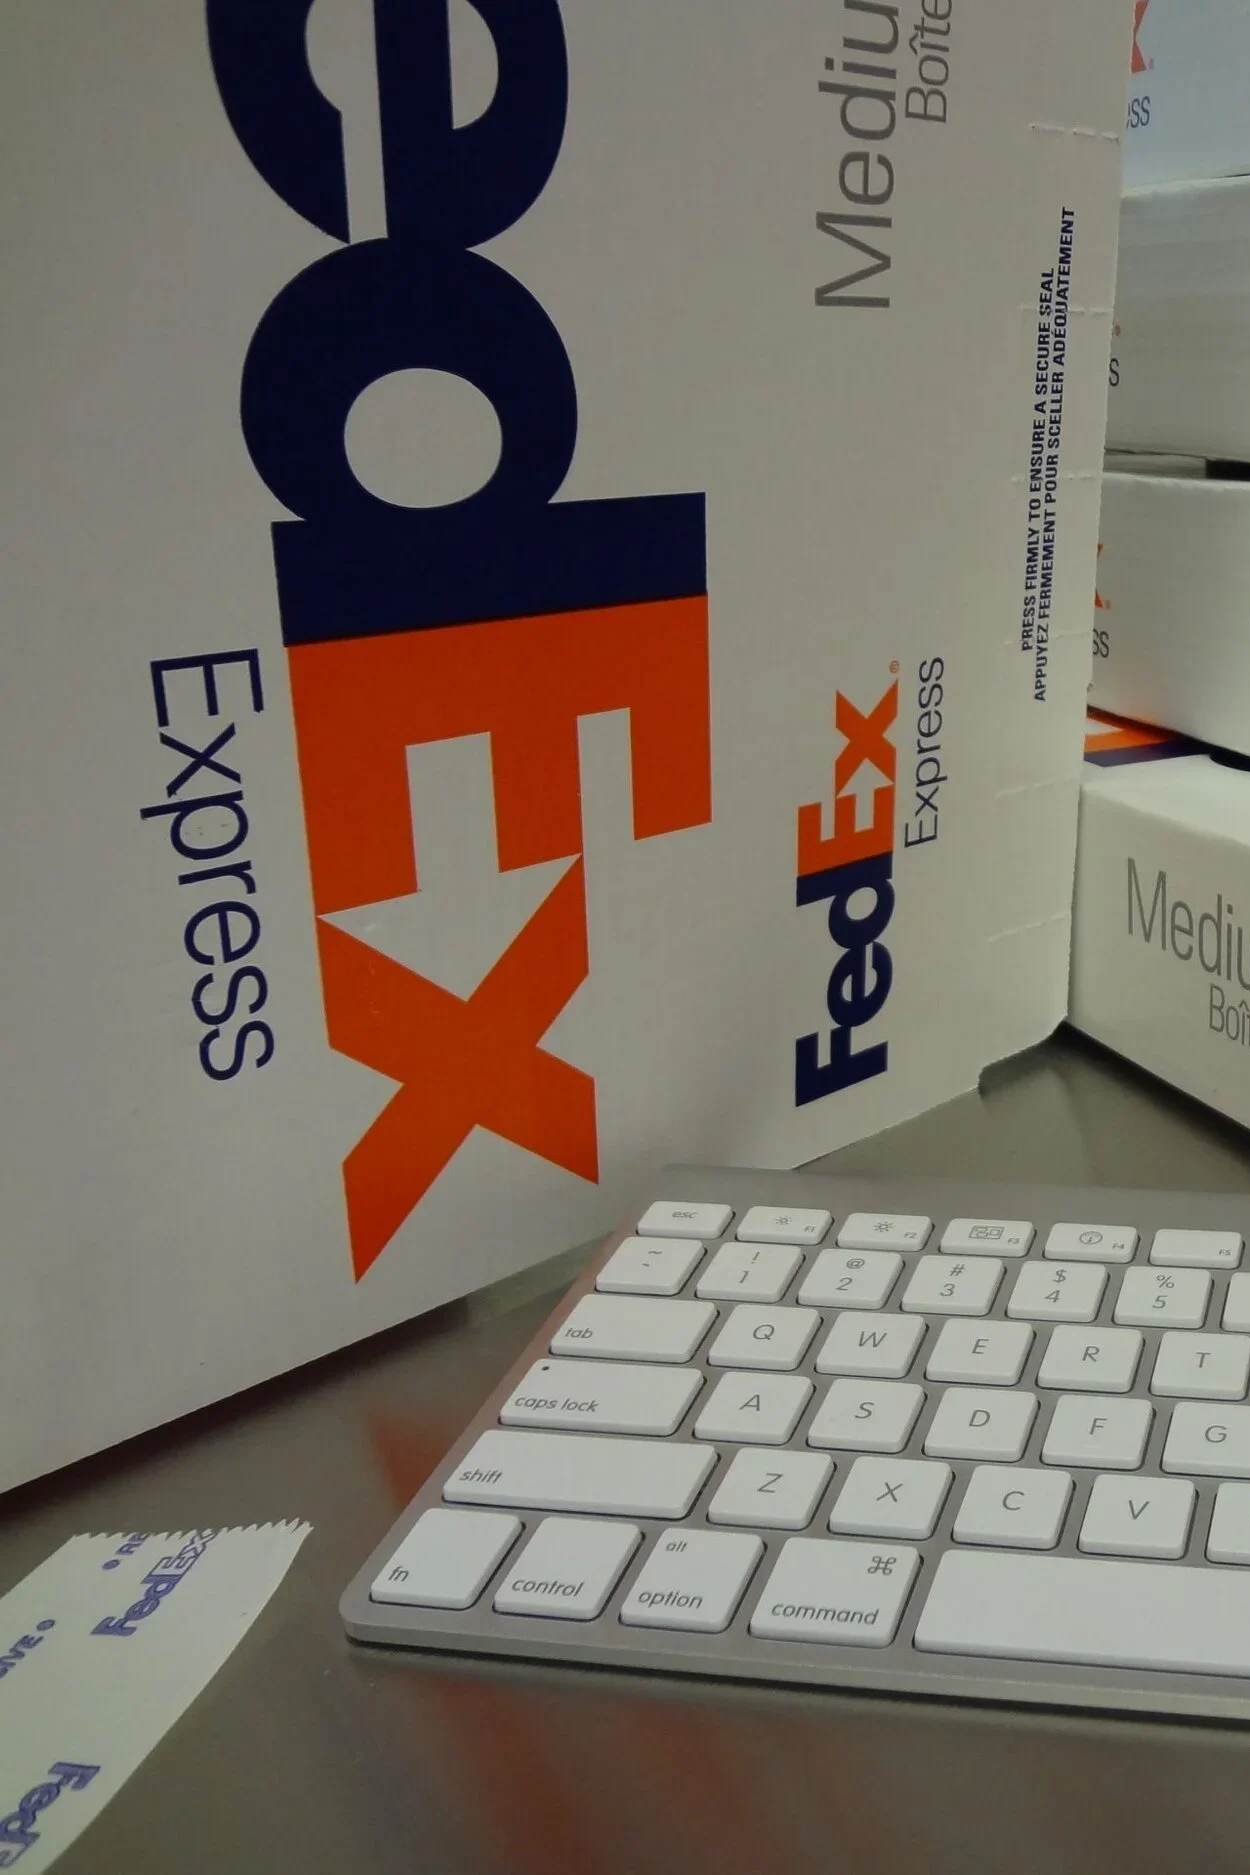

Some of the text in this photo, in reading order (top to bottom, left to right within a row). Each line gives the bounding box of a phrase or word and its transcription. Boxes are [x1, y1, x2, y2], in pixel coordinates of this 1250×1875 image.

[815, 0, 900, 308] Mediu
[1048, 371, 1065, 449] SCELLER
[1021, 267, 1054, 651] PRESS FIRMLY TO ENSURE A SECURE SEAL
[1044, 454, 1060, 504] POUR
[1038, 509, 1056, 619] FERMEMENT
[205, 0, 712, 1284] edEx
[1034, 623, 1050, 701] APPUYEZ
[904, 656, 948, 848] Express
[140, 648, 275, 1082] Express
[795, 678, 899, 1108] FedEx
[671, 1211, 698, 1219] esc
[845, 1257, 866, 1270] @
[949, 1264, 965, 1277] #
[738, 1270, 750, 1284] 1
[835, 1276, 854, 1292] 2
[1052, 1268, 1067, 1284] $
[1155, 1274, 1176, 1289] %
[939, 1283, 956, 1297] 3
[1044, 1289, 1061, 1304] 4
[1151, 1294, 1168, 1310] 5
[564, 1327, 594, 1339] tab
[752, 1323, 775, 1341] Q
[858, 1331, 888, 1348] W
[971, 1338, 989, 1355] E
[1081, 1345, 1100, 1363] R
[1196, 1351, 1212, 1369] T
[514, 1397, 599, 1413] caps lock
[738, 1393, 761, 1412] A
[854, 1401, 875, 1420] S
[968, 1409, 991, 1428] D
[1089, 1417, 1108, 1436] F
[1204, 1425, 1228, 1444] G
[459, 1468, 503, 1484] shift
[756, 1472, 784, 1494] Z
[875, 1481, 904, 1503] X
[1001, 1490, 1025, 1511] C
[1128, 1499, 1150, 1521] V
[665, 1540, 688, 1553] alt
[387, 1565, 410, 1582] fn
[511, 1579, 585, 1597] control
[638, 1591, 703, 1609] option
[771, 1603, 880, 1625] command
